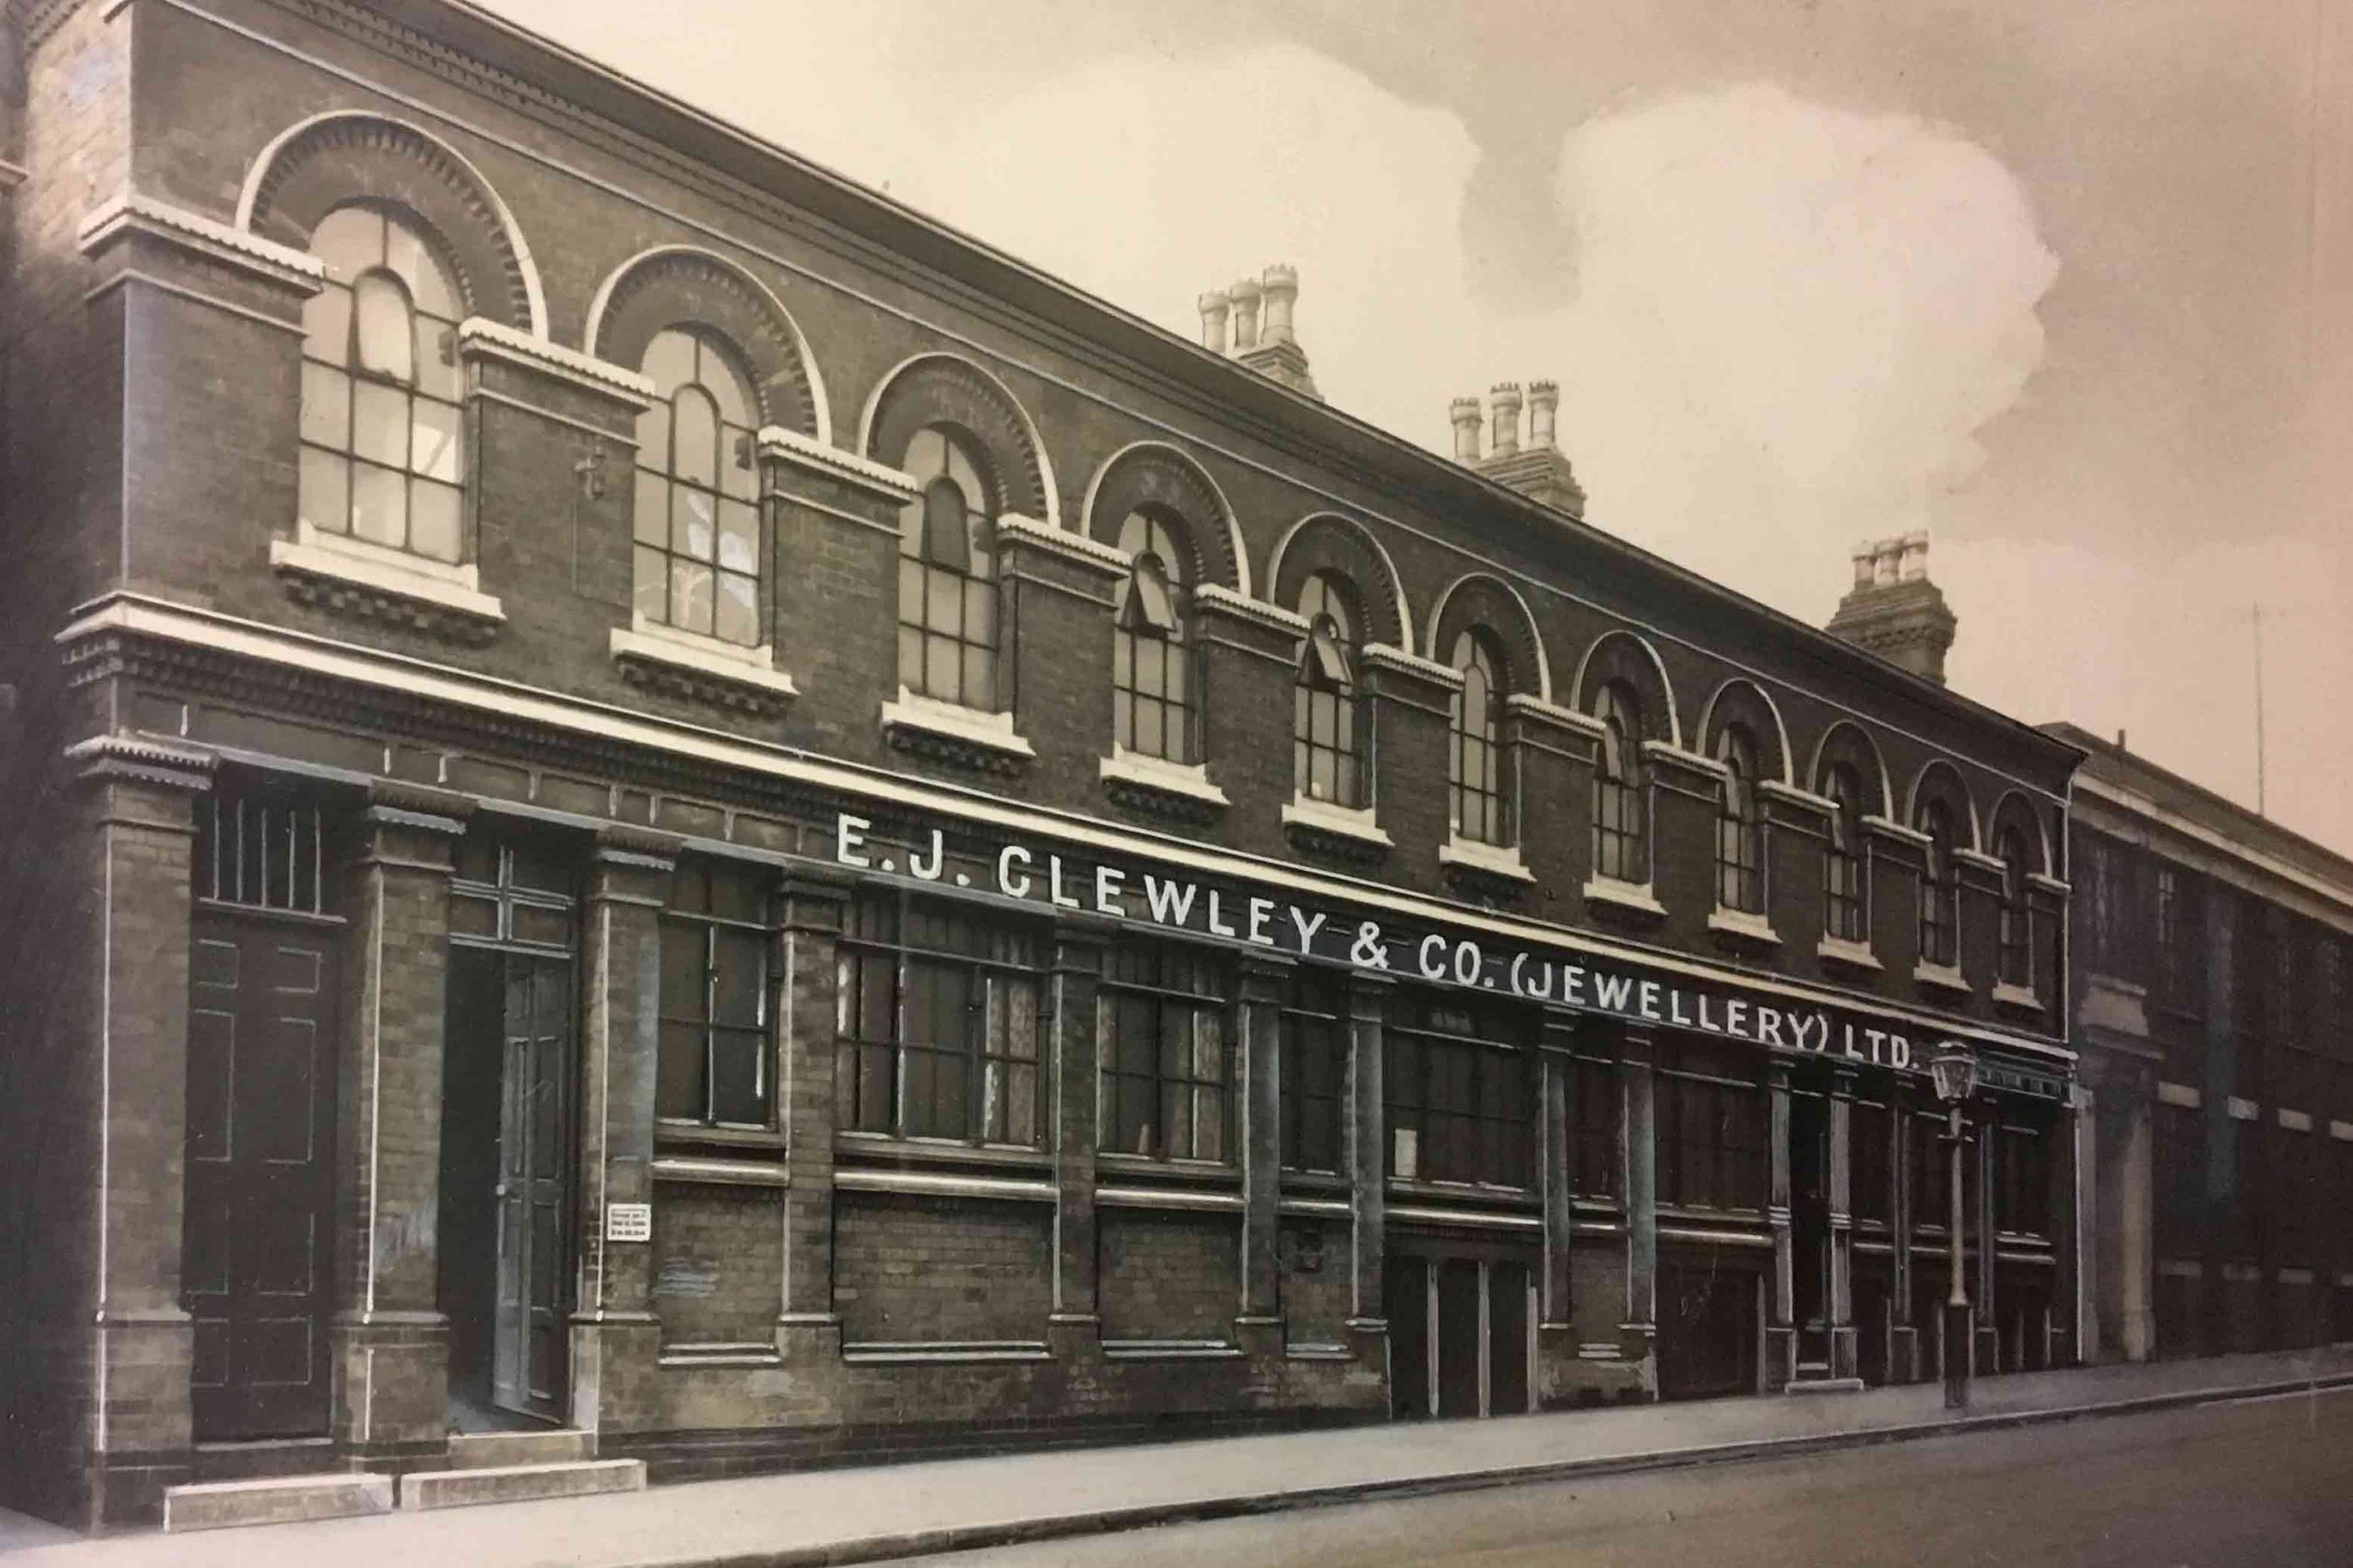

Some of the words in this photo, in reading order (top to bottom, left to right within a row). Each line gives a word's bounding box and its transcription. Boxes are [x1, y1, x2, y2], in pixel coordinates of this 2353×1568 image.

[998, 846, 1326, 955] CLEWLEY
[1350, 921, 1388, 970] &
[1419, 934, 1495, 987] CO.
[1511, 952, 1828, 1052] (JEWELLERY)
[1846, 1024, 1919, 1070] LTD.
